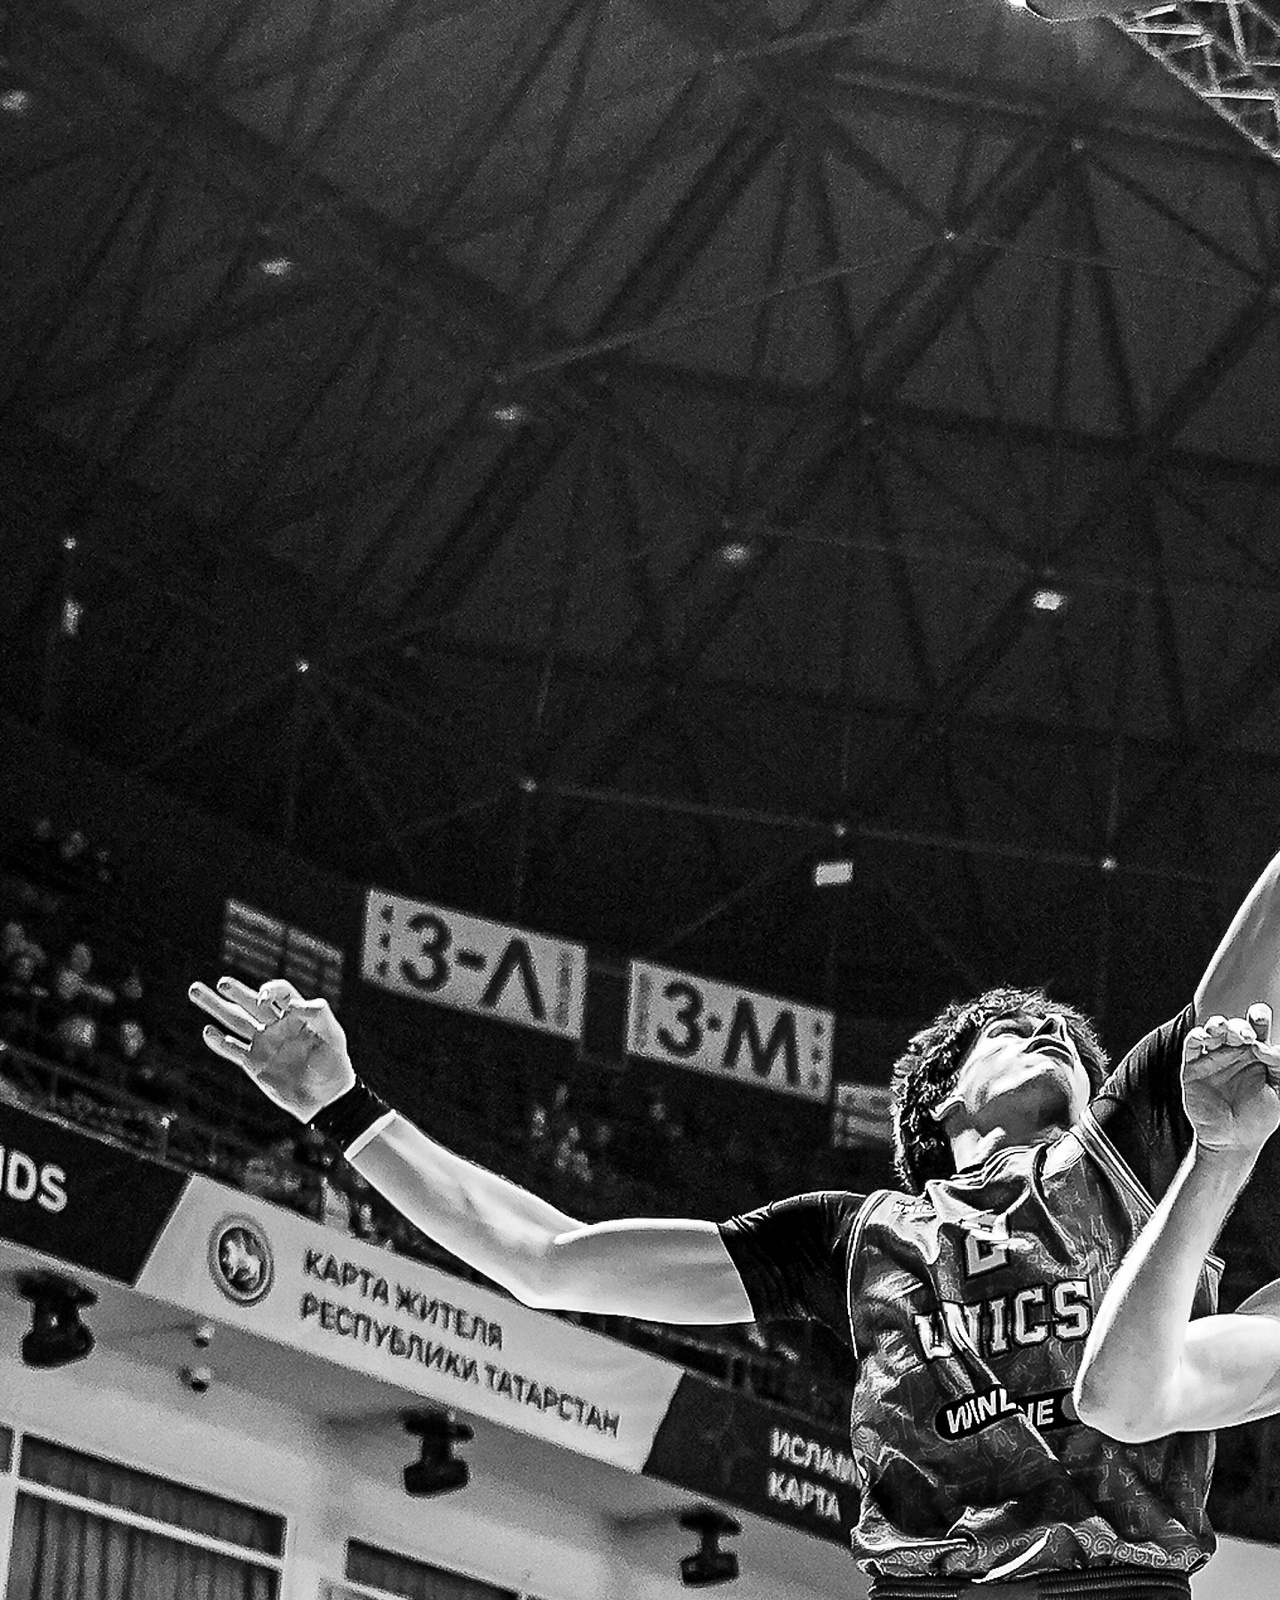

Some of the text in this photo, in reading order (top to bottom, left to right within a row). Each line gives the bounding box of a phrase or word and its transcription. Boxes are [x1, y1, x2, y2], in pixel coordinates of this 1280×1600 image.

[0, 1143, 68, 1213] DS
[301, 1248, 503, 1351] КАРТА ЖИТЕЛЯ
[299, 1291, 621, 1440] РЕСПУБЛИКИ ТАТАРСТАН
[767, 1470, 842, 1522] КАРТА
